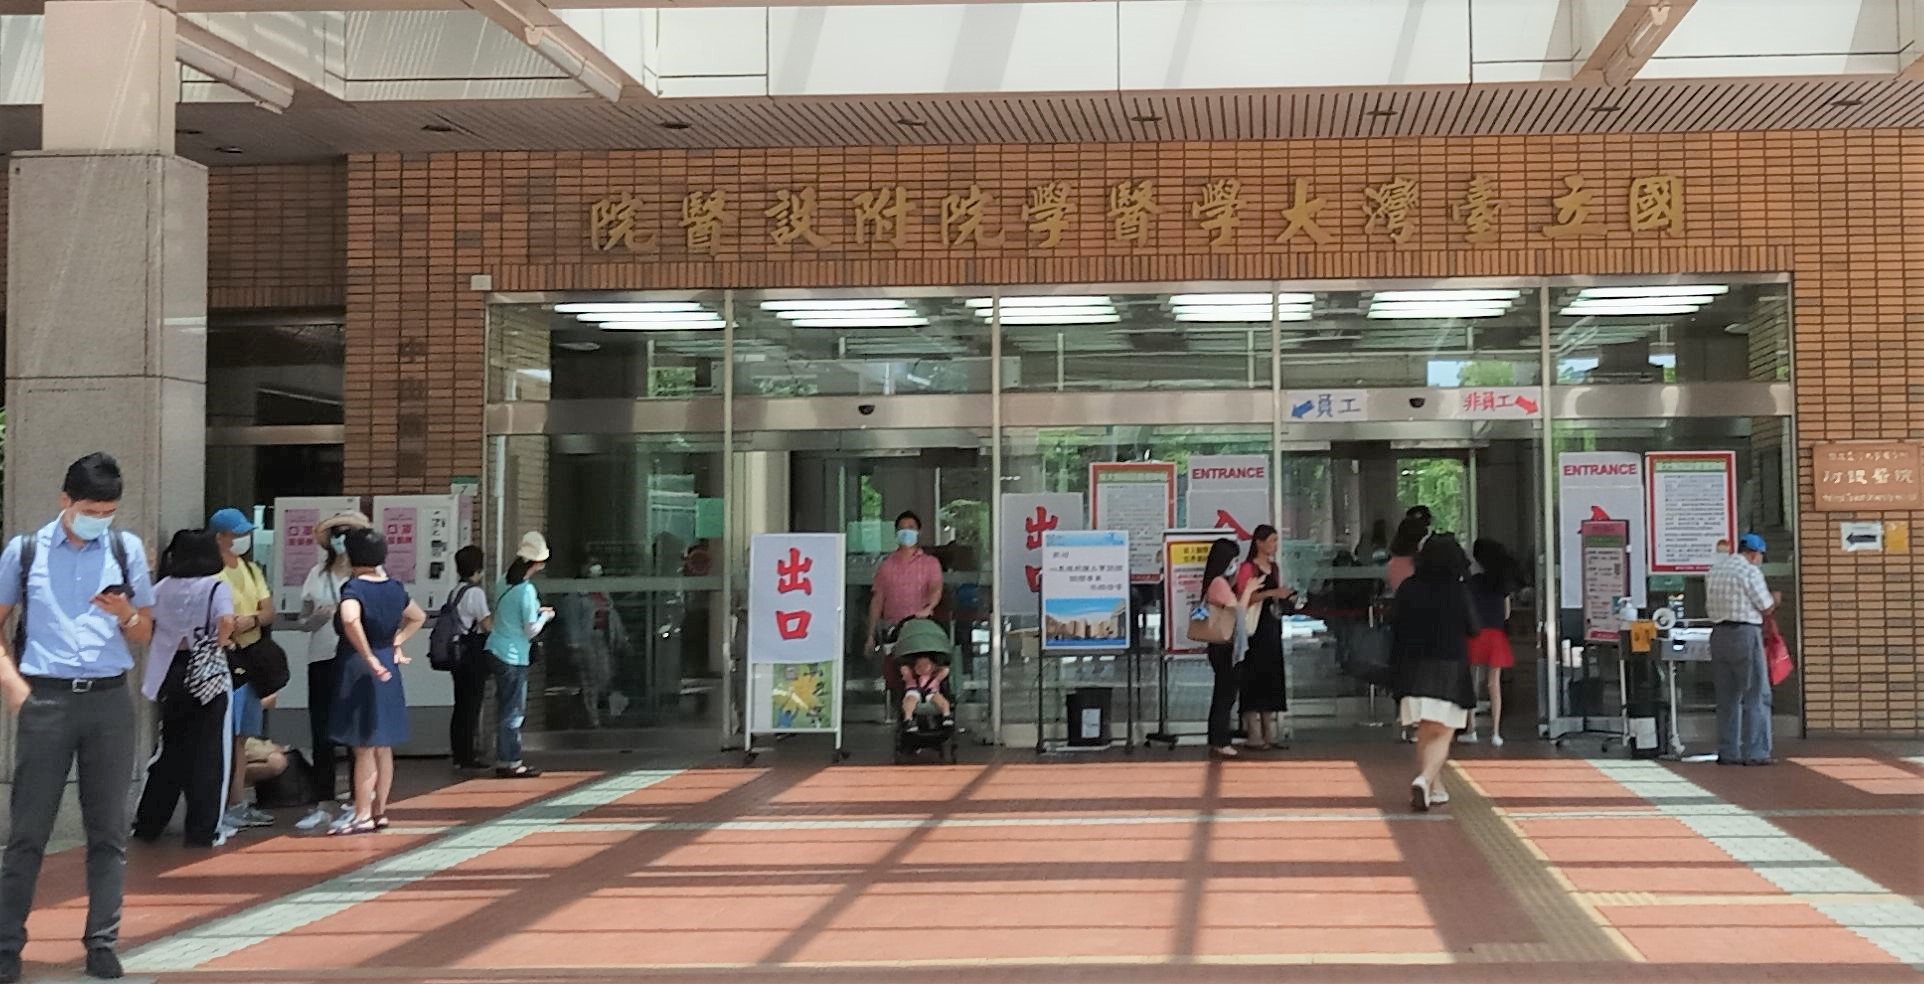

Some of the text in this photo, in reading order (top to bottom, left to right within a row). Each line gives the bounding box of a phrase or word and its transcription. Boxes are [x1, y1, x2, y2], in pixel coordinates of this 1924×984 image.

[1316, 393, 1361, 418] 員工
[1463, 391, 1514, 413] 非員工
[1192, 466, 1265, 480] ENTRANCE
[1563, 463, 1638, 477] ENTRANCE
[775, 547, 813, 640] 出口
